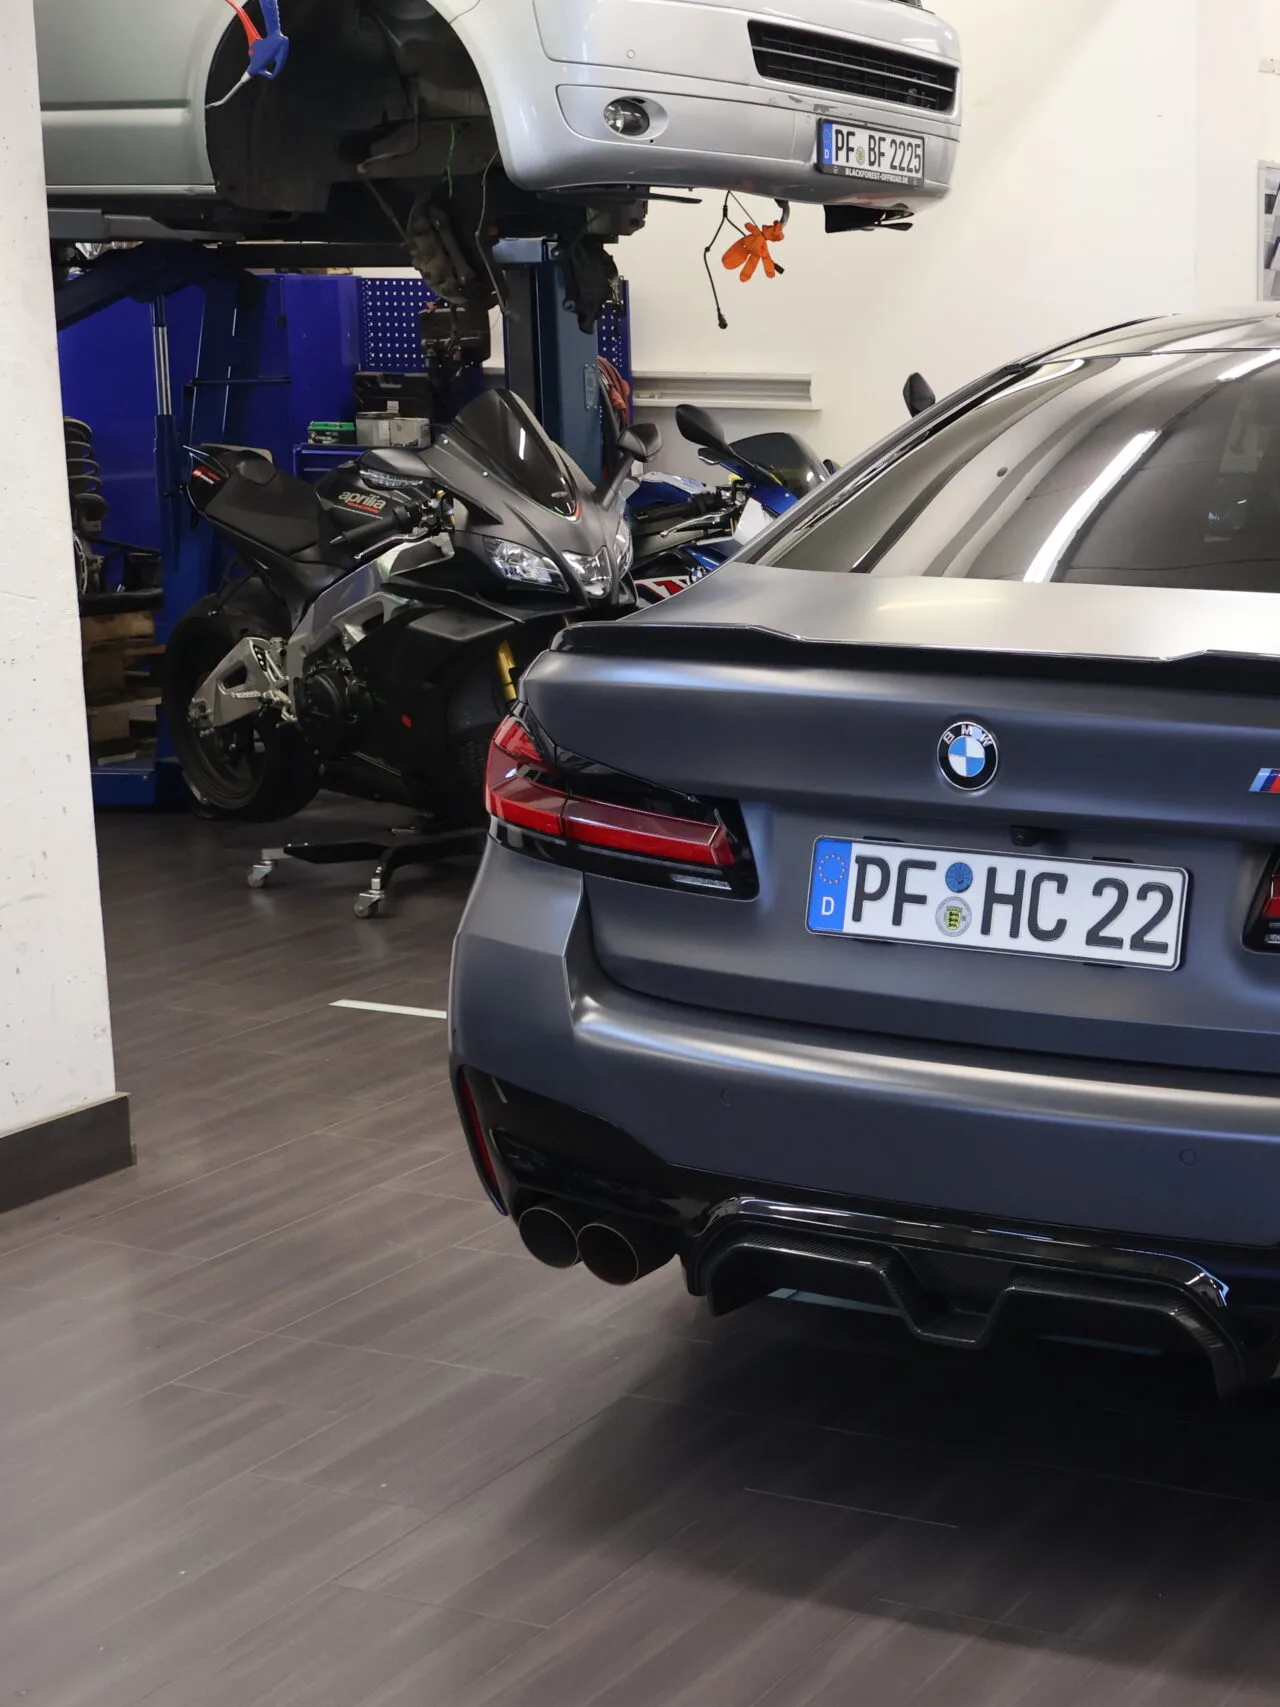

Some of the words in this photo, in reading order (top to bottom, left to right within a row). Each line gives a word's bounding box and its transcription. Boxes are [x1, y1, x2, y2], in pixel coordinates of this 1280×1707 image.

[824, 148, 830, 159] D
[835, 128, 855, 163] PF
[868, 134, 886, 168] BF
[890, 138, 922, 174] 2225
[338, 491, 386, 510] aprilia
[943, 725, 993, 748] BMW
[821, 896, 835, 916] D
[852, 854, 937, 927] PF
[980, 866, 1069, 942] HC
[1085, 877, 1175, 954] 22
